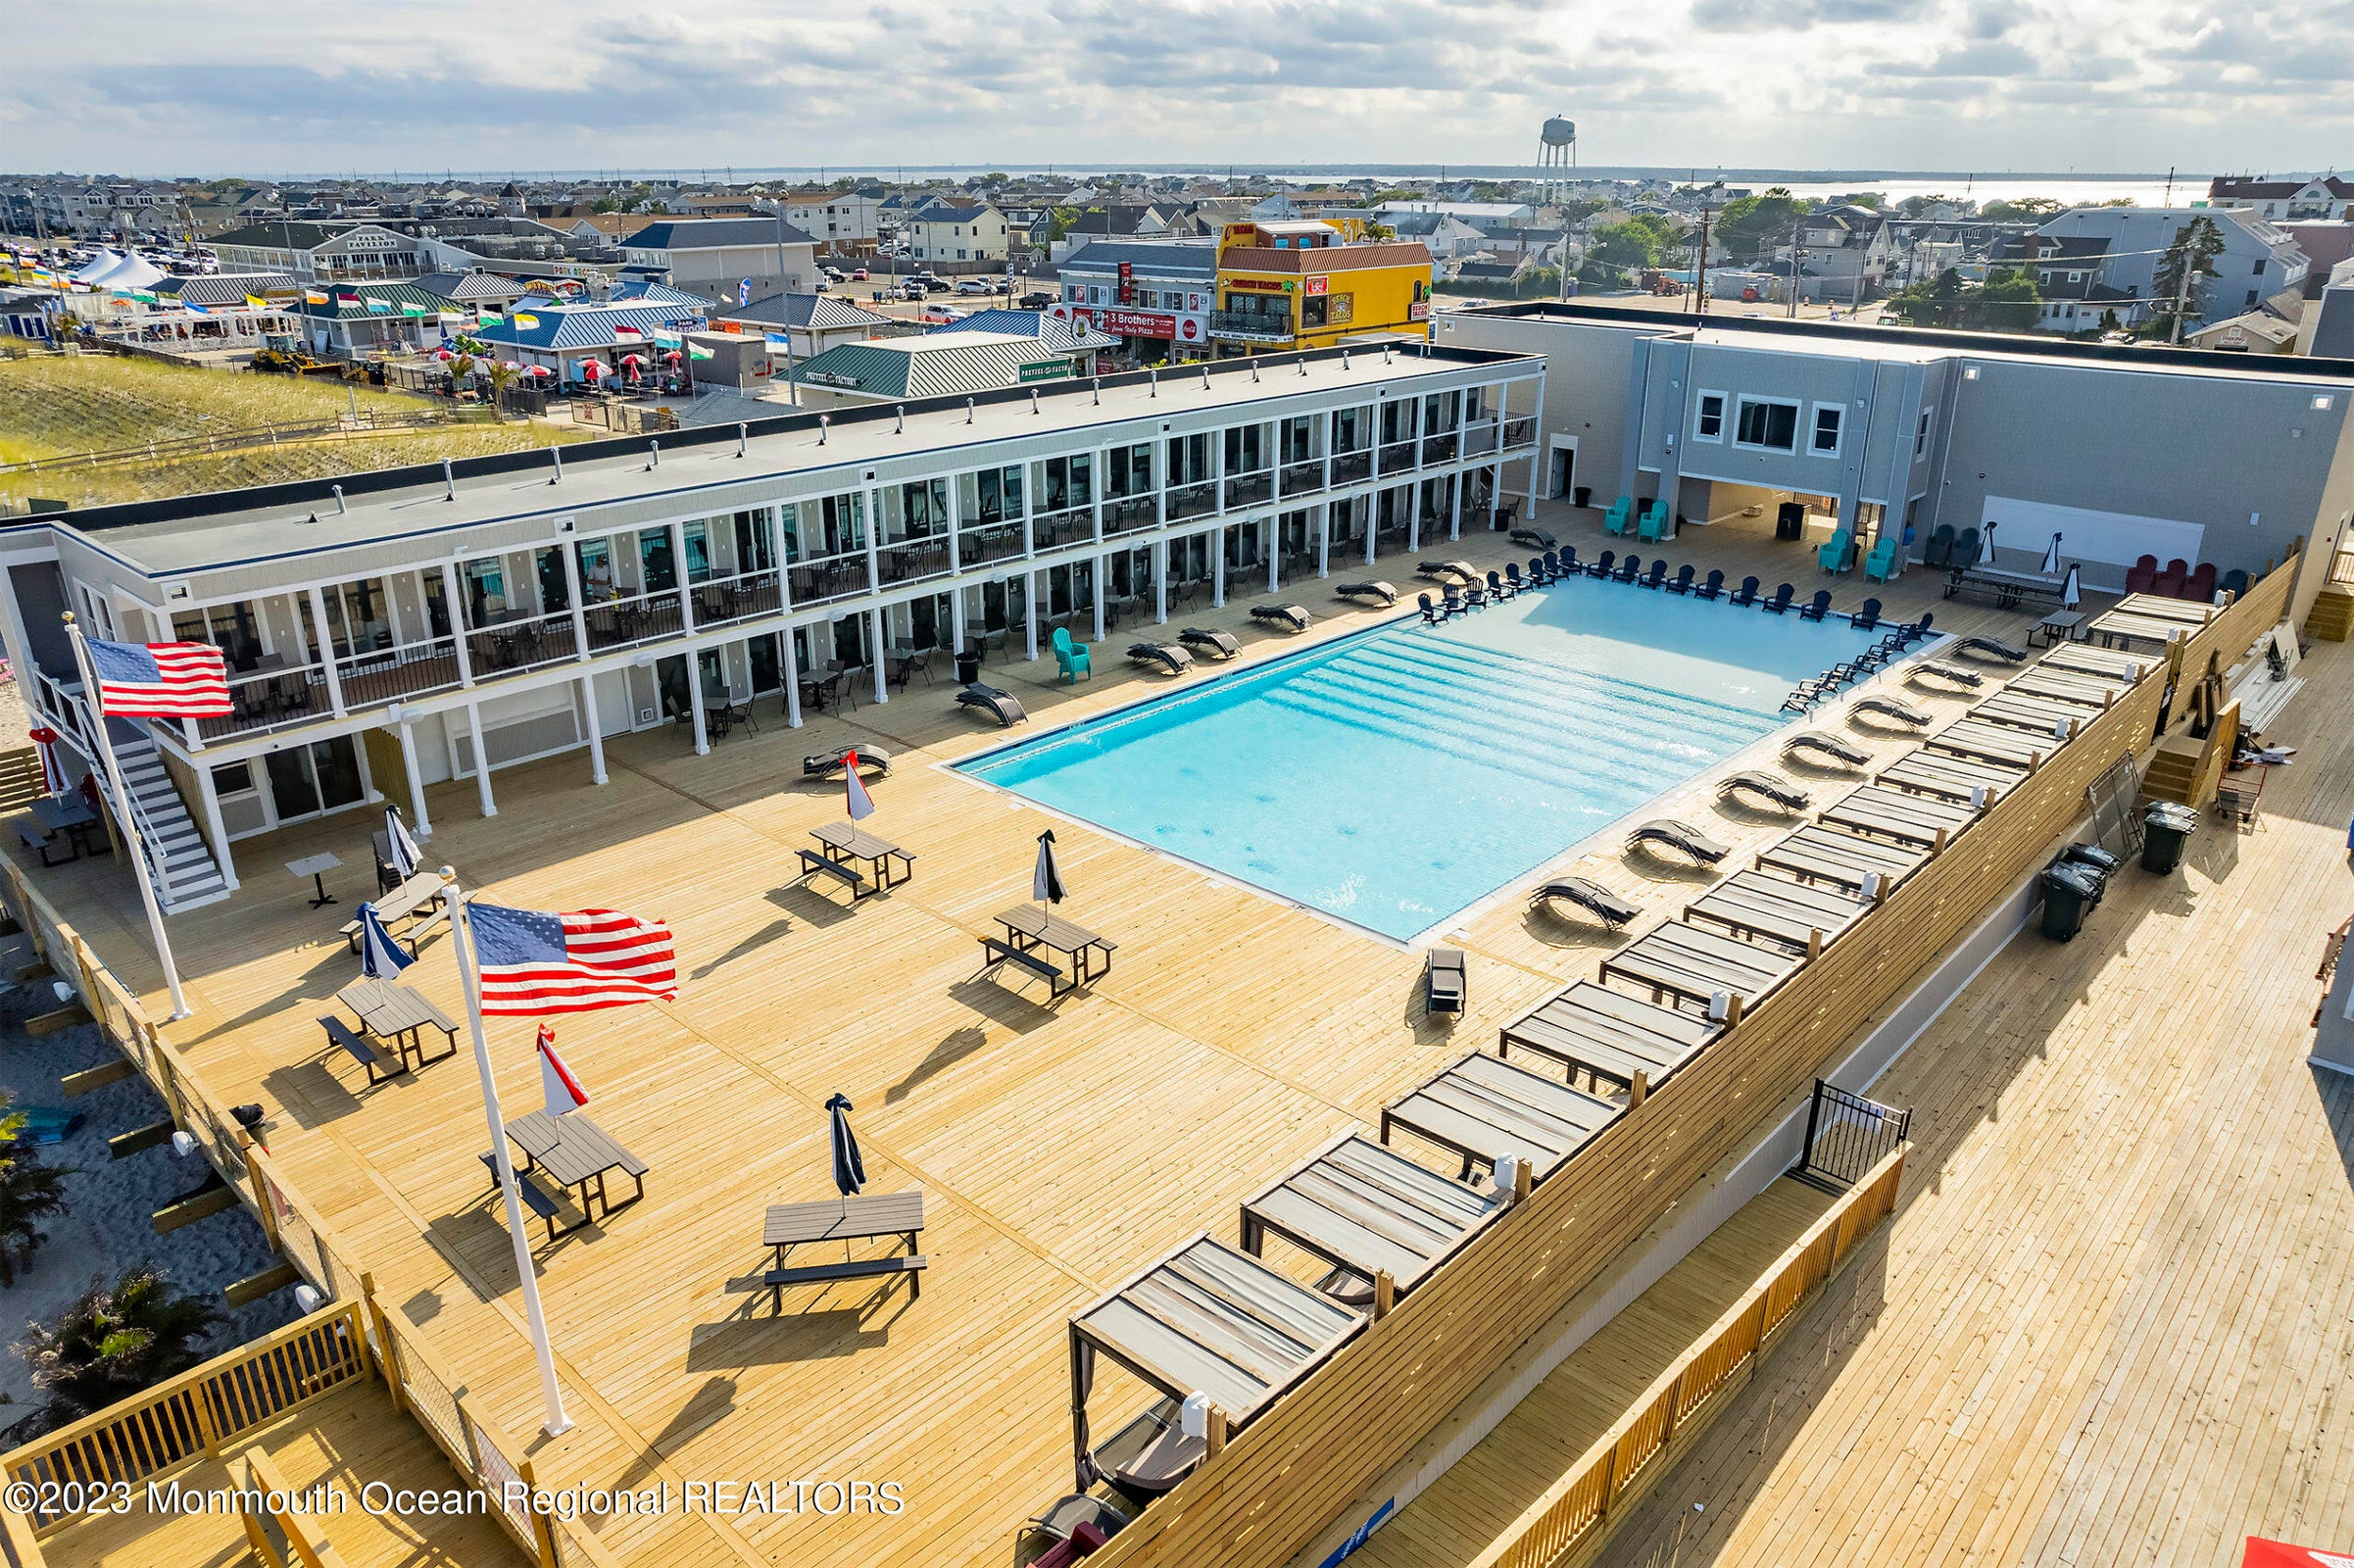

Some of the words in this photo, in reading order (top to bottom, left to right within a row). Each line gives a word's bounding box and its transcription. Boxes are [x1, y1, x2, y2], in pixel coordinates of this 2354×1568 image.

[1257, 280, 1283, 291] TACOS
[1331, 294, 1350, 305] BEACH
[1110, 314, 1117, 323] 3
[1118, 314, 1155, 326] Brothers
[1330, 310, 1351, 320] TACOS
[666, 323, 706, 333] SEAFOOD
[1138, 325, 1154, 335] Pizza
[1020, 367, 1044, 377] PRETZEL
[1052, 364, 1075, 373] FACTOY
[806, 371, 828, 382] PRETZEL
[835, 375, 858, 386] FACTORY
